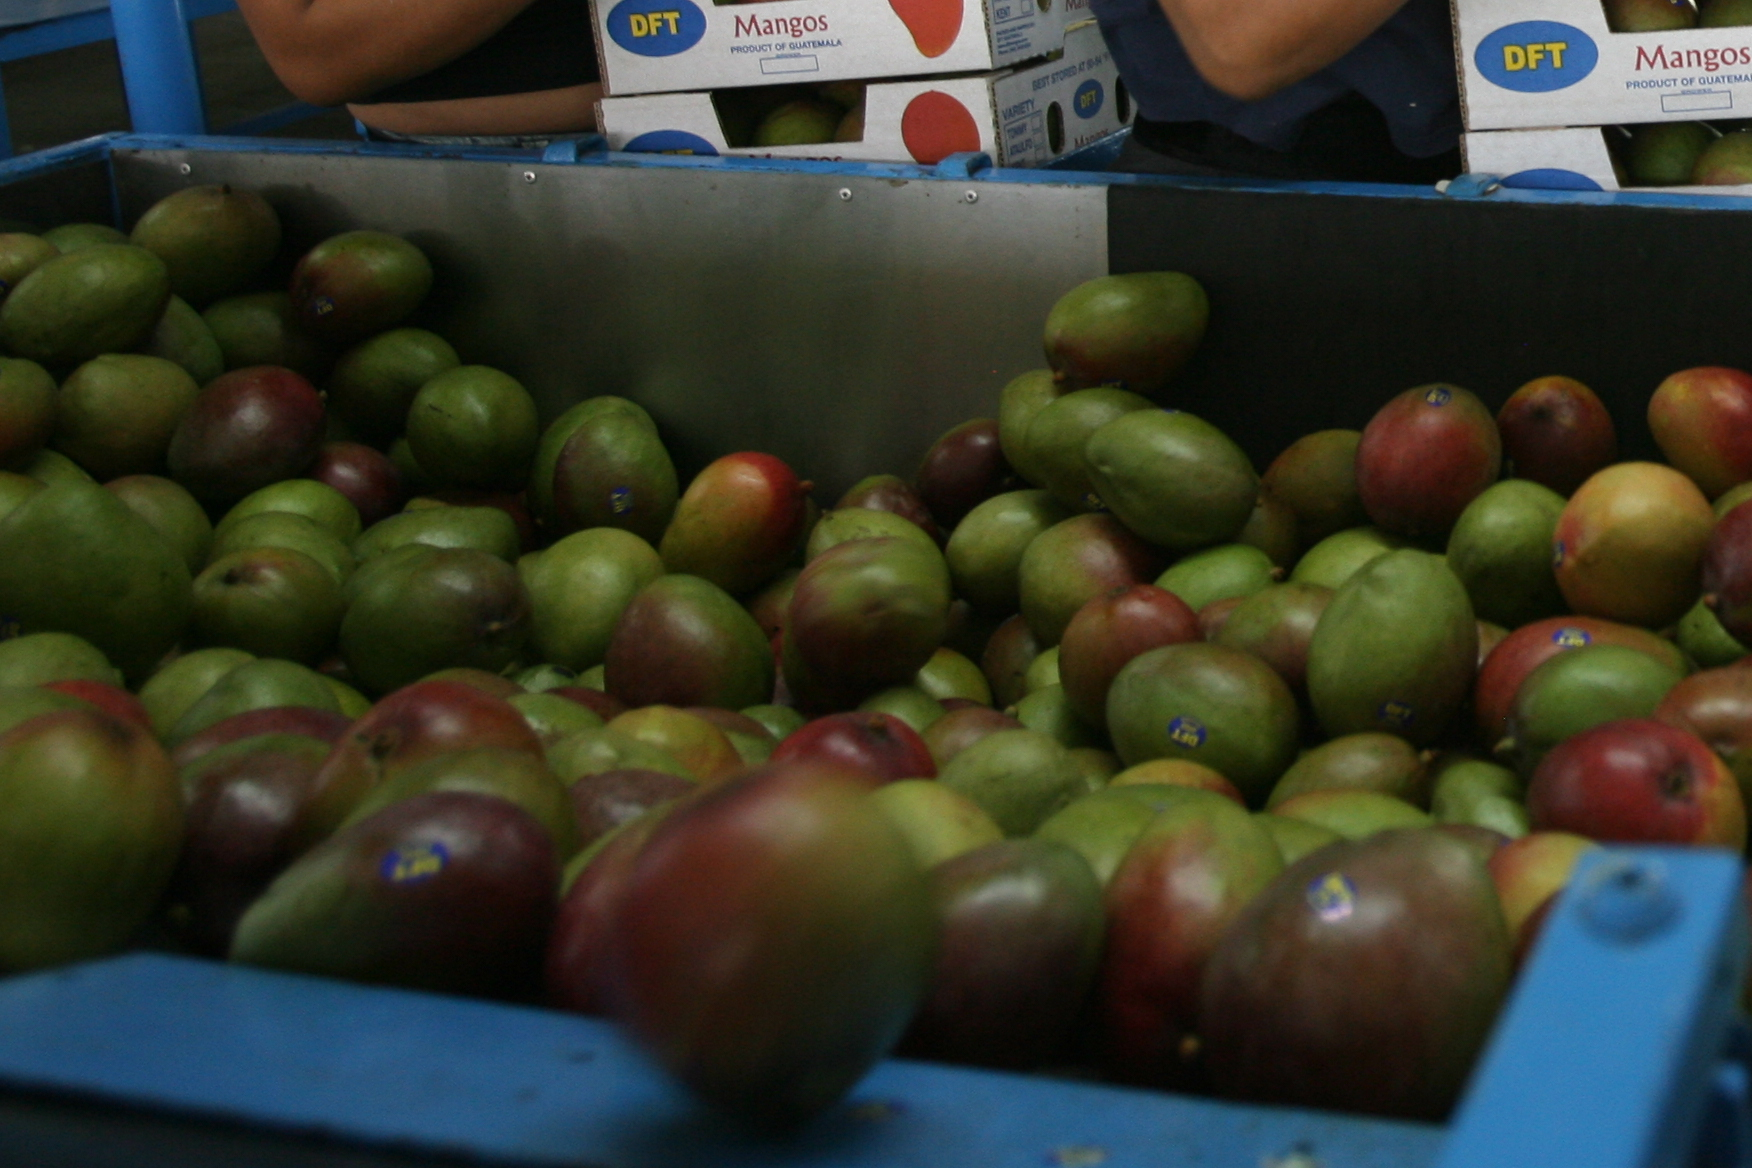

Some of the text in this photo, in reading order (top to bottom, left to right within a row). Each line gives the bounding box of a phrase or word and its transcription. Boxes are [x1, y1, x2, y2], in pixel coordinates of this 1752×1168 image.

[629, 10, 681, 38] DFT
[735, 13, 829, 39] Mangos
[730, 39, 843, 54] PRODUCT OF GUATEMALA
[1503, 41, 1568, 72] DFT
[1635, 45, 1752, 73] Mangos
[1625, 77, 1678, 89] PRODUCT
[1681, 77, 1696, 87] OF
